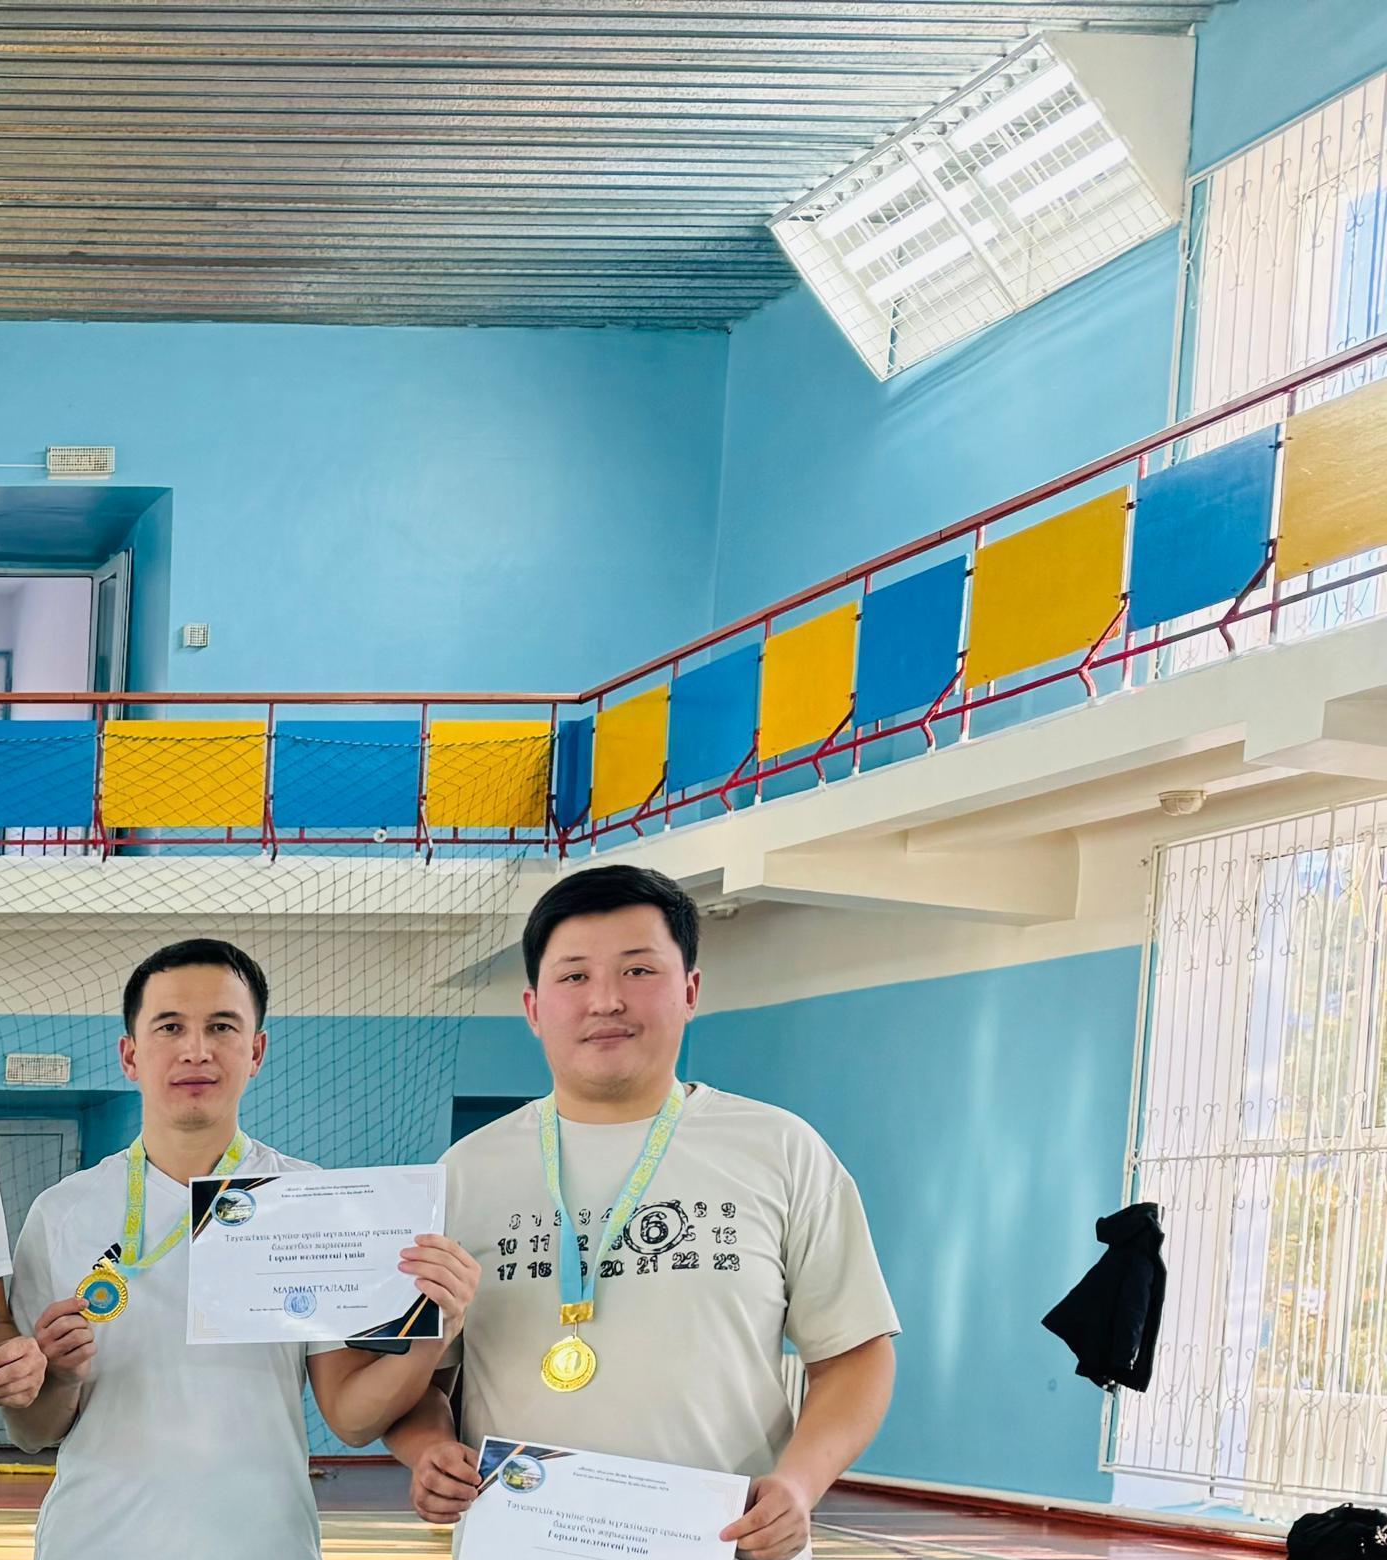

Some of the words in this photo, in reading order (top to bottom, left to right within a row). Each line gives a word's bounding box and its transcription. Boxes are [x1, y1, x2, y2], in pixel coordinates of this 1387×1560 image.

[640, 1210, 669, 1245] 6
[497, 1238, 518, 1256] 10
[529, 1233, 551, 1253] 11
[497, 1262, 517, 1281] 17
[600, 1260, 624, 1279] 20
[636, 1253, 659, 1275] 21
[672, 1251, 700, 1271] 22
